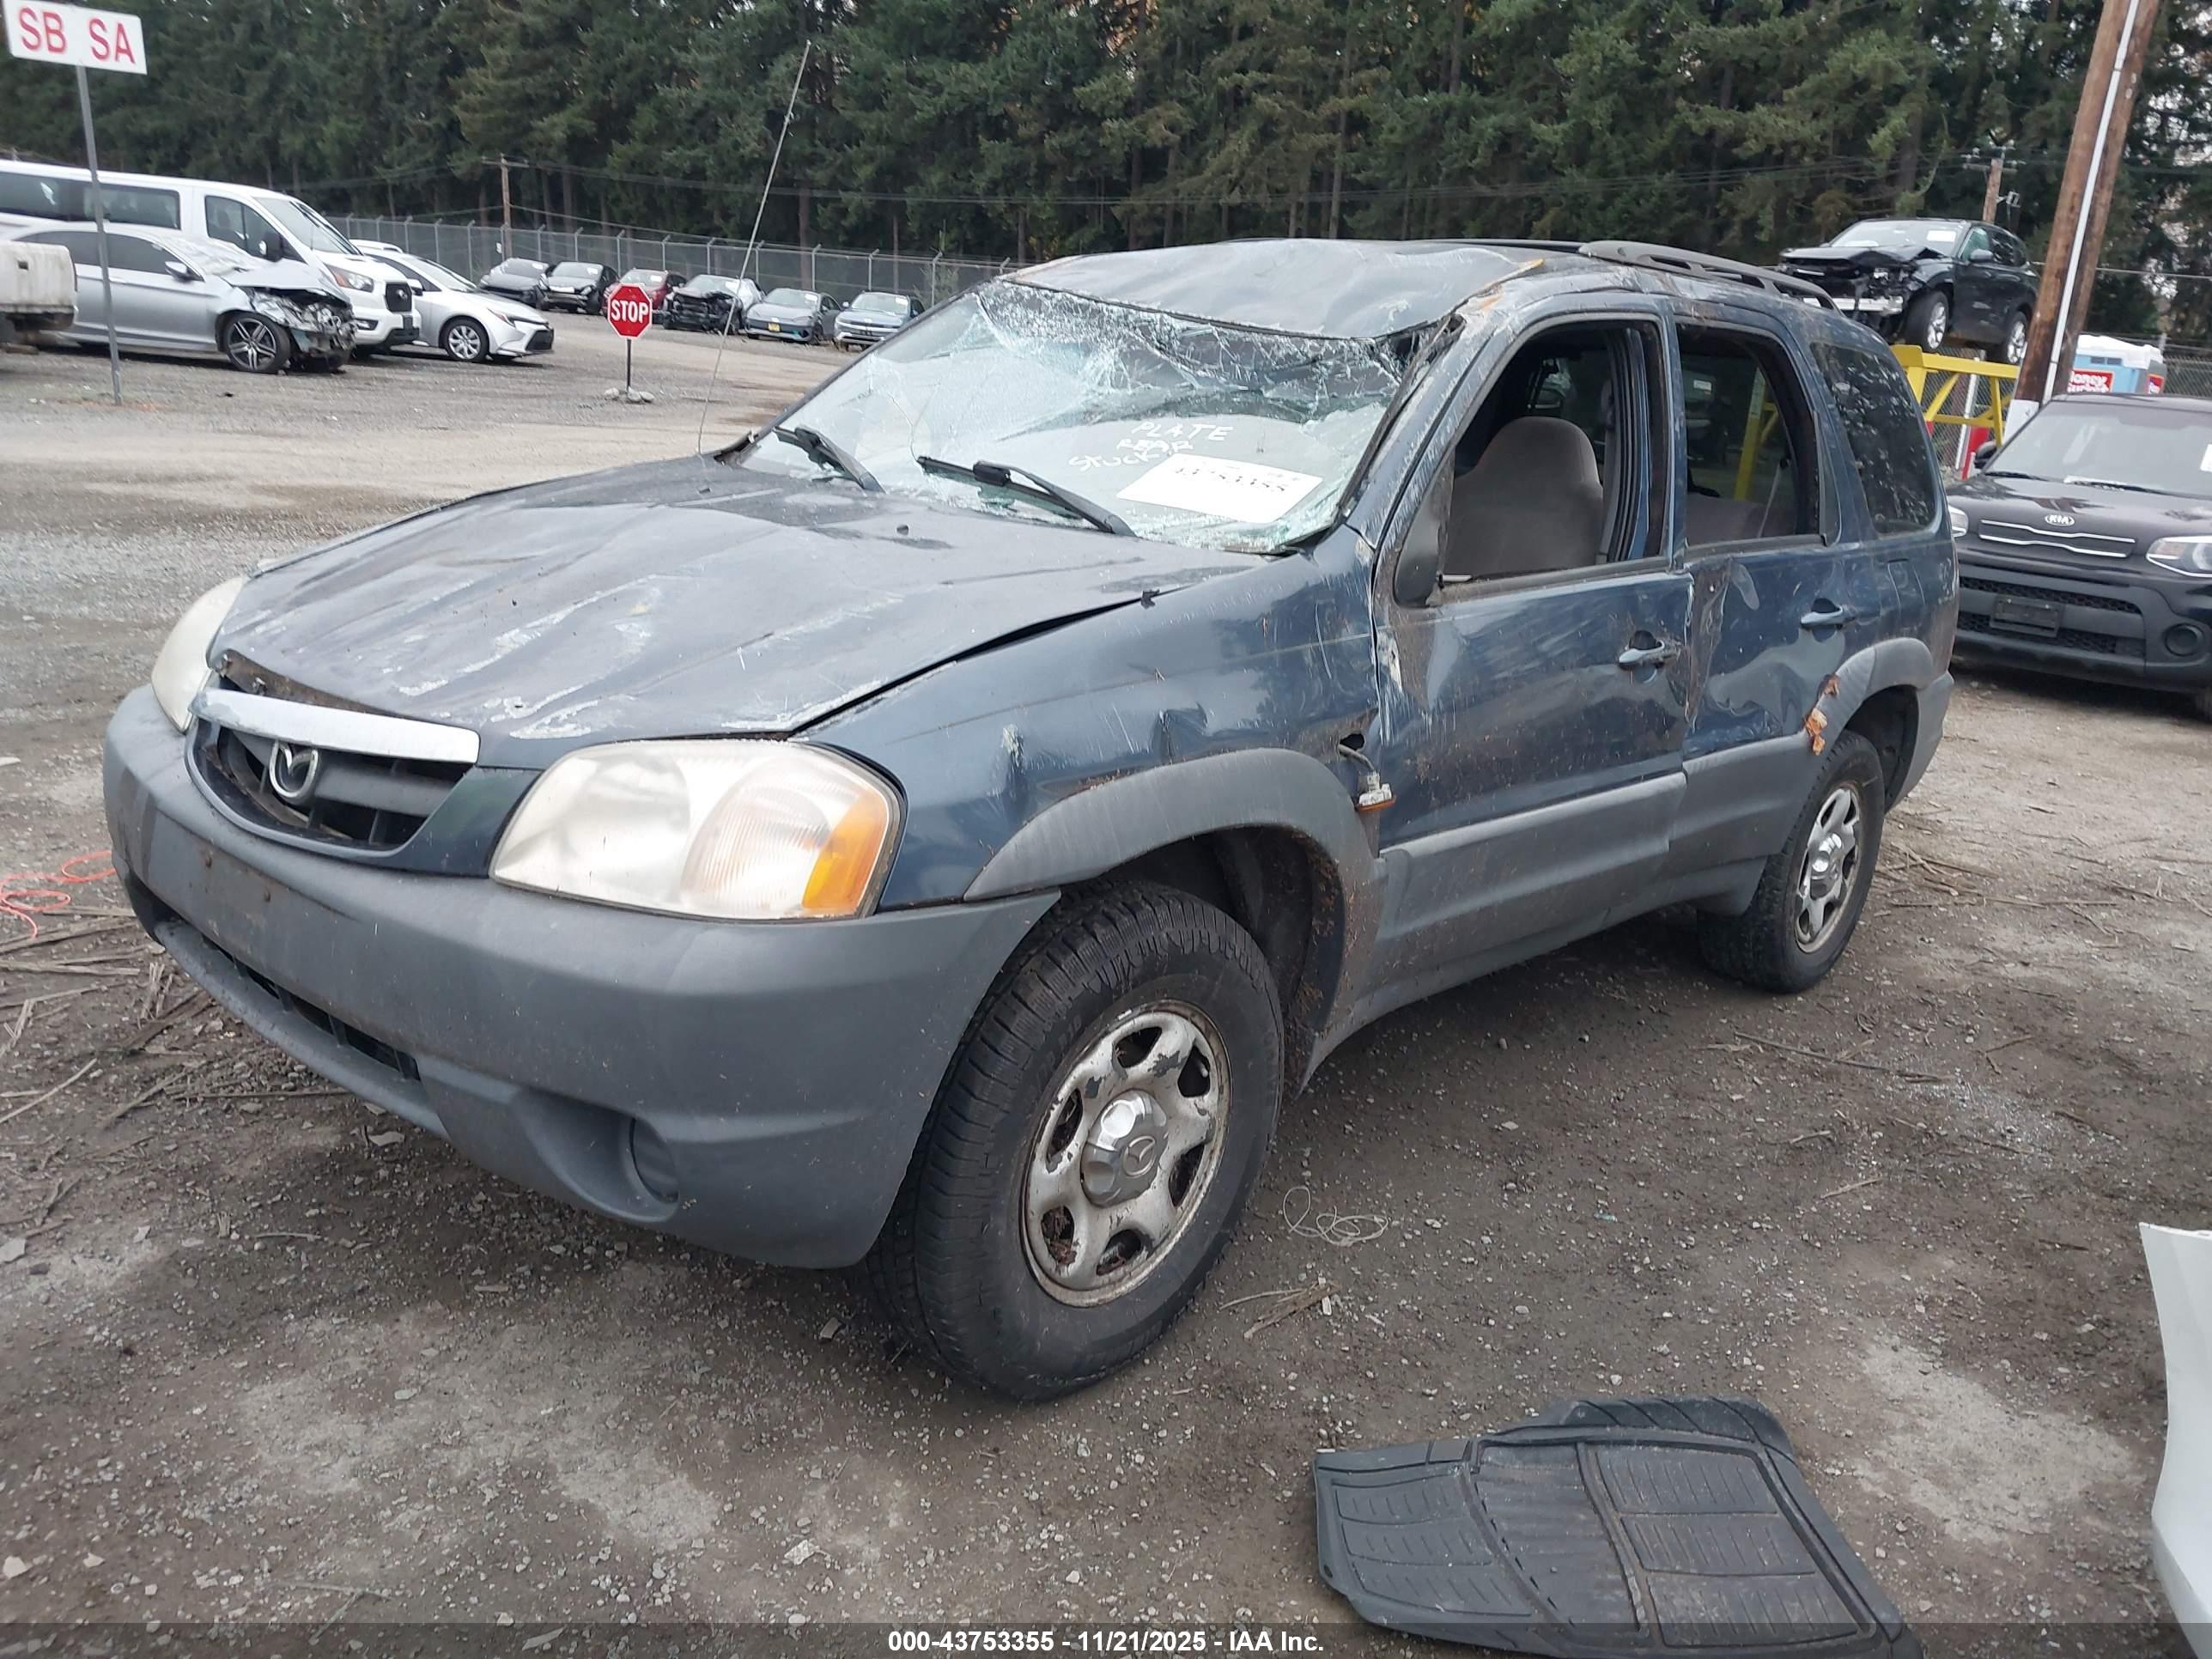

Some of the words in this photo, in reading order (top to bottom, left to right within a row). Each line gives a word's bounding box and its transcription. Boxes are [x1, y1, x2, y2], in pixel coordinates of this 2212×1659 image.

[19, 7, 66, 52] SB
[88, 18, 136, 64] SA
[611, 299, 649, 324] STOP
[1131, 421, 1234, 441] PLATE
[1068, 451, 1160, 471] STUCK
[2047, 514, 2071, 526] KIA
